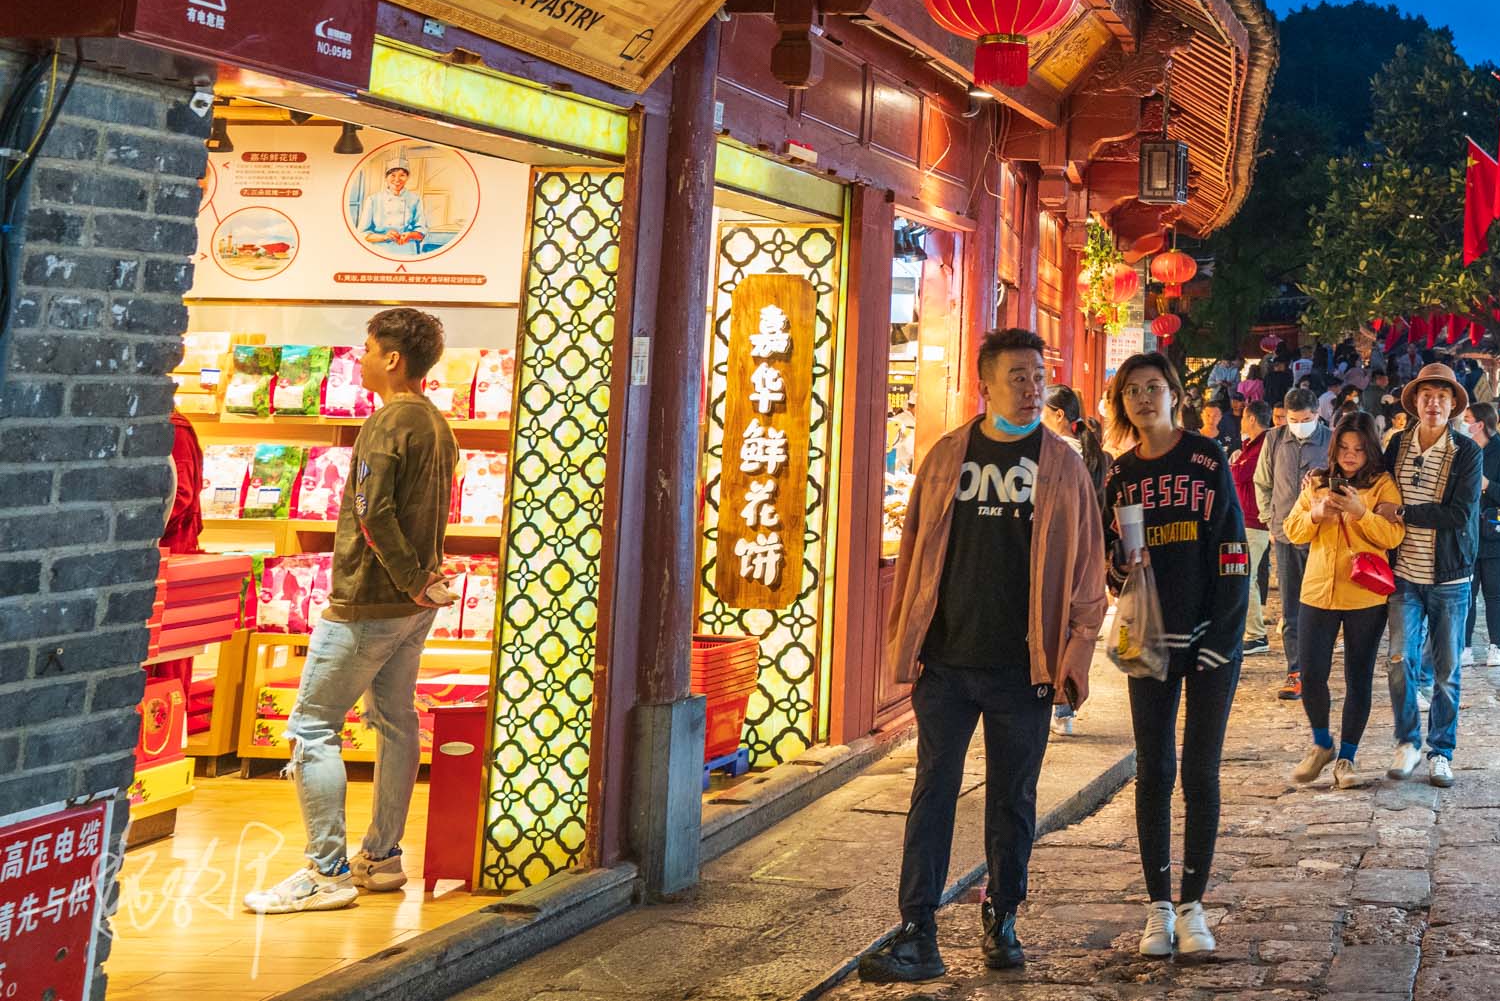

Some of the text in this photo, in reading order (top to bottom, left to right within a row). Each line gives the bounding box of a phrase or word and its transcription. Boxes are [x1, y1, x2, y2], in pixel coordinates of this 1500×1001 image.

[187, 7, 226, 30] 有电危险
[733, 303, 792, 587] 嘉华鲜花饼
[1190, 453, 1219, 472] NOISE
[978, 505, 1004, 517] TAKE
[0, 819, 102, 883] 高压电缆
